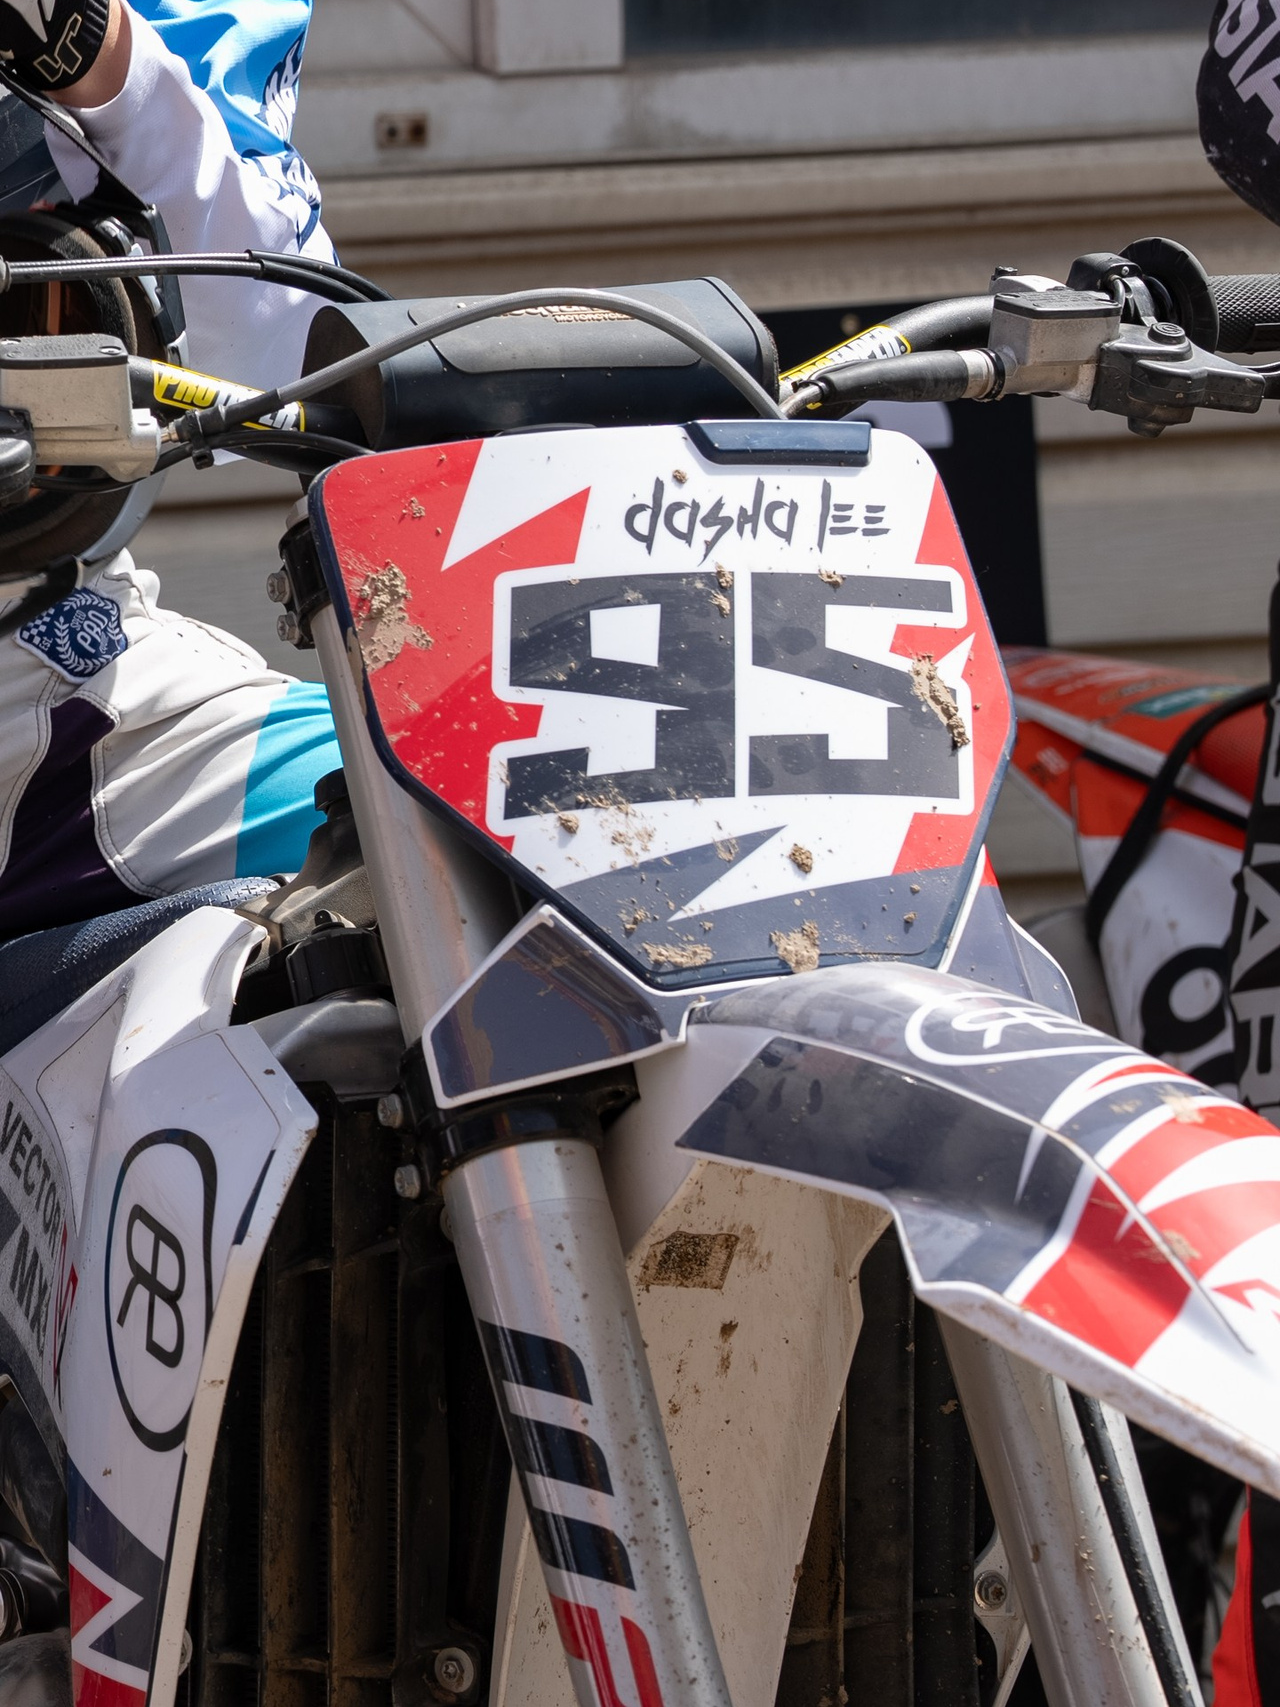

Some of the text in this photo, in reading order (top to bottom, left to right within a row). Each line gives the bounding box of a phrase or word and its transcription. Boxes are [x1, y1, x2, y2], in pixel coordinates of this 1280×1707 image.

[70, 609, 87, 632] SPEED
[503, 571, 960, 820] 95
[0, 1100, 62, 1260] VECTOR
